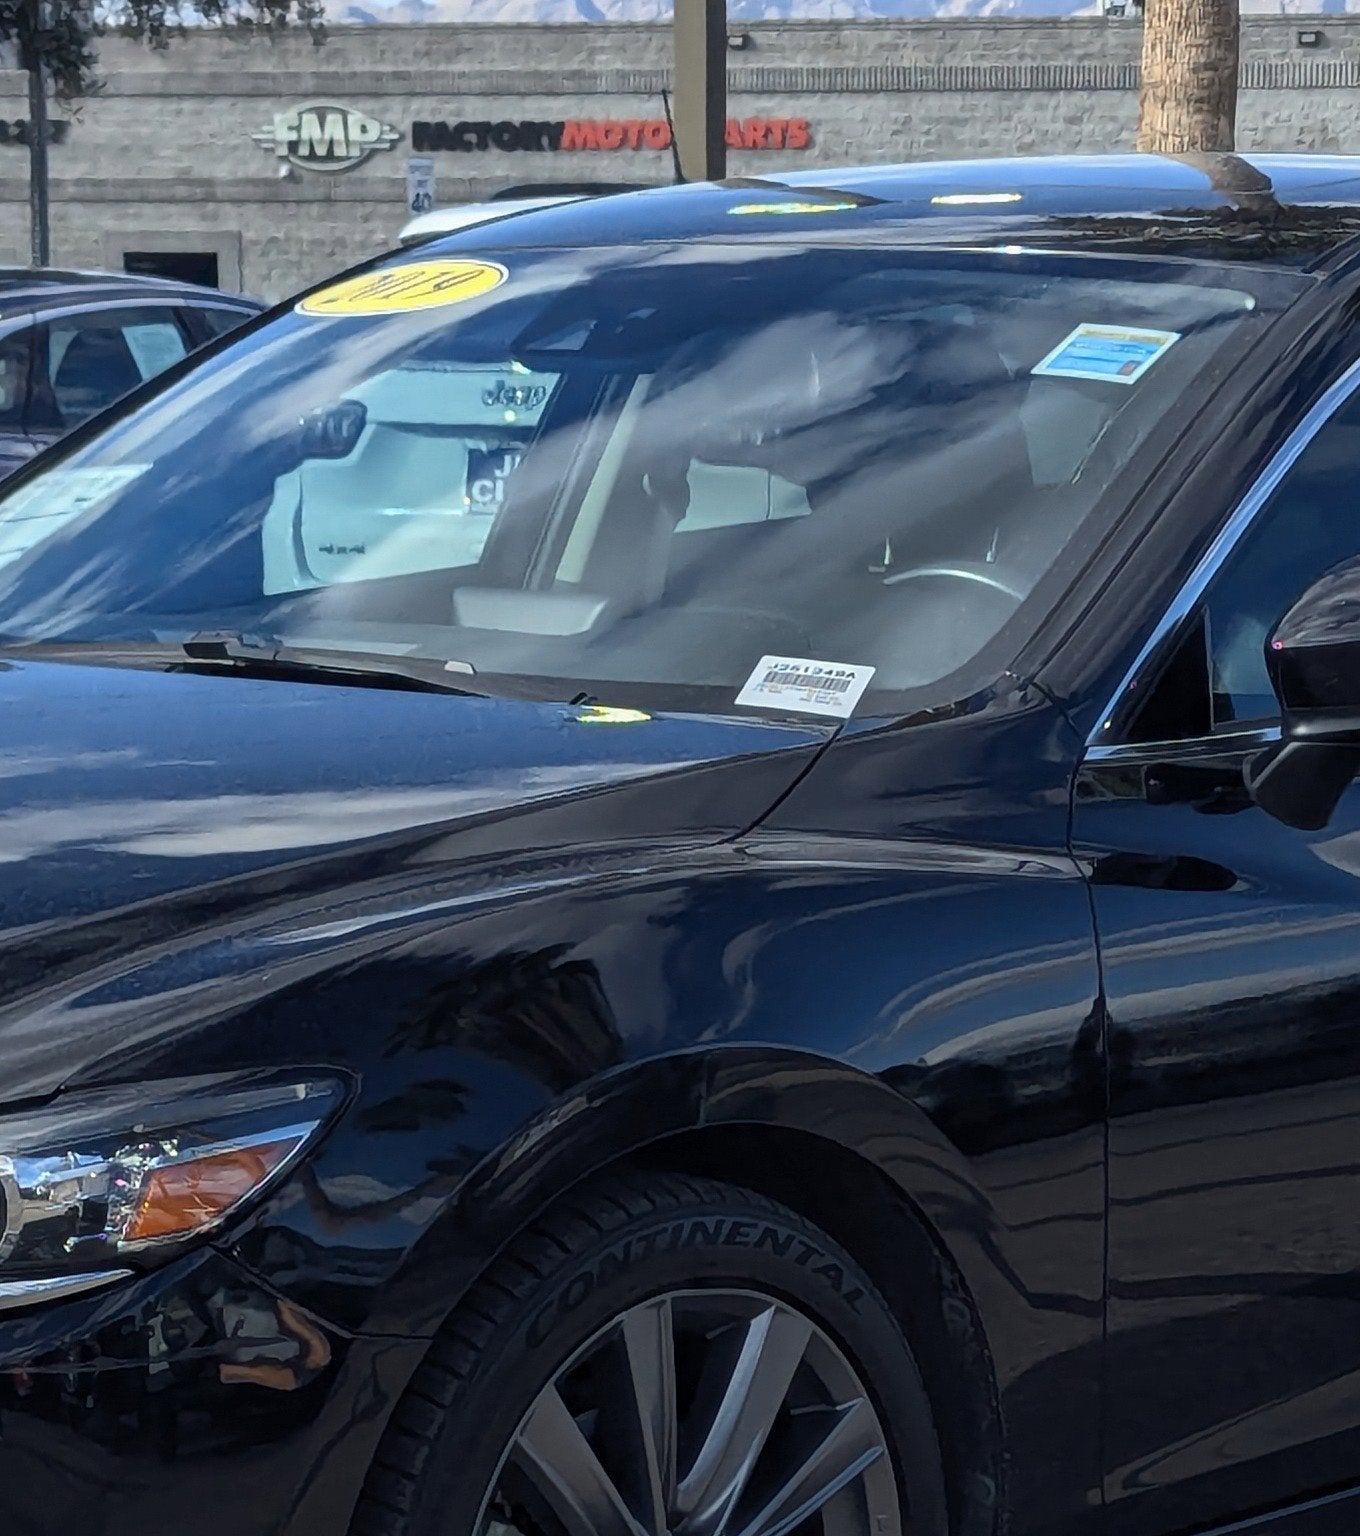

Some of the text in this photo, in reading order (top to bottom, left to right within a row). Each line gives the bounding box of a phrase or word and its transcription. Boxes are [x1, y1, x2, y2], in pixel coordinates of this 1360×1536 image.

[273, 112, 382, 157] FMP
[412, 117, 810, 151] FACTORY MOTO ARTS
[481, 379, 547, 411] Jeep
[525, 1218, 864, 1349] CONTINENTAL
